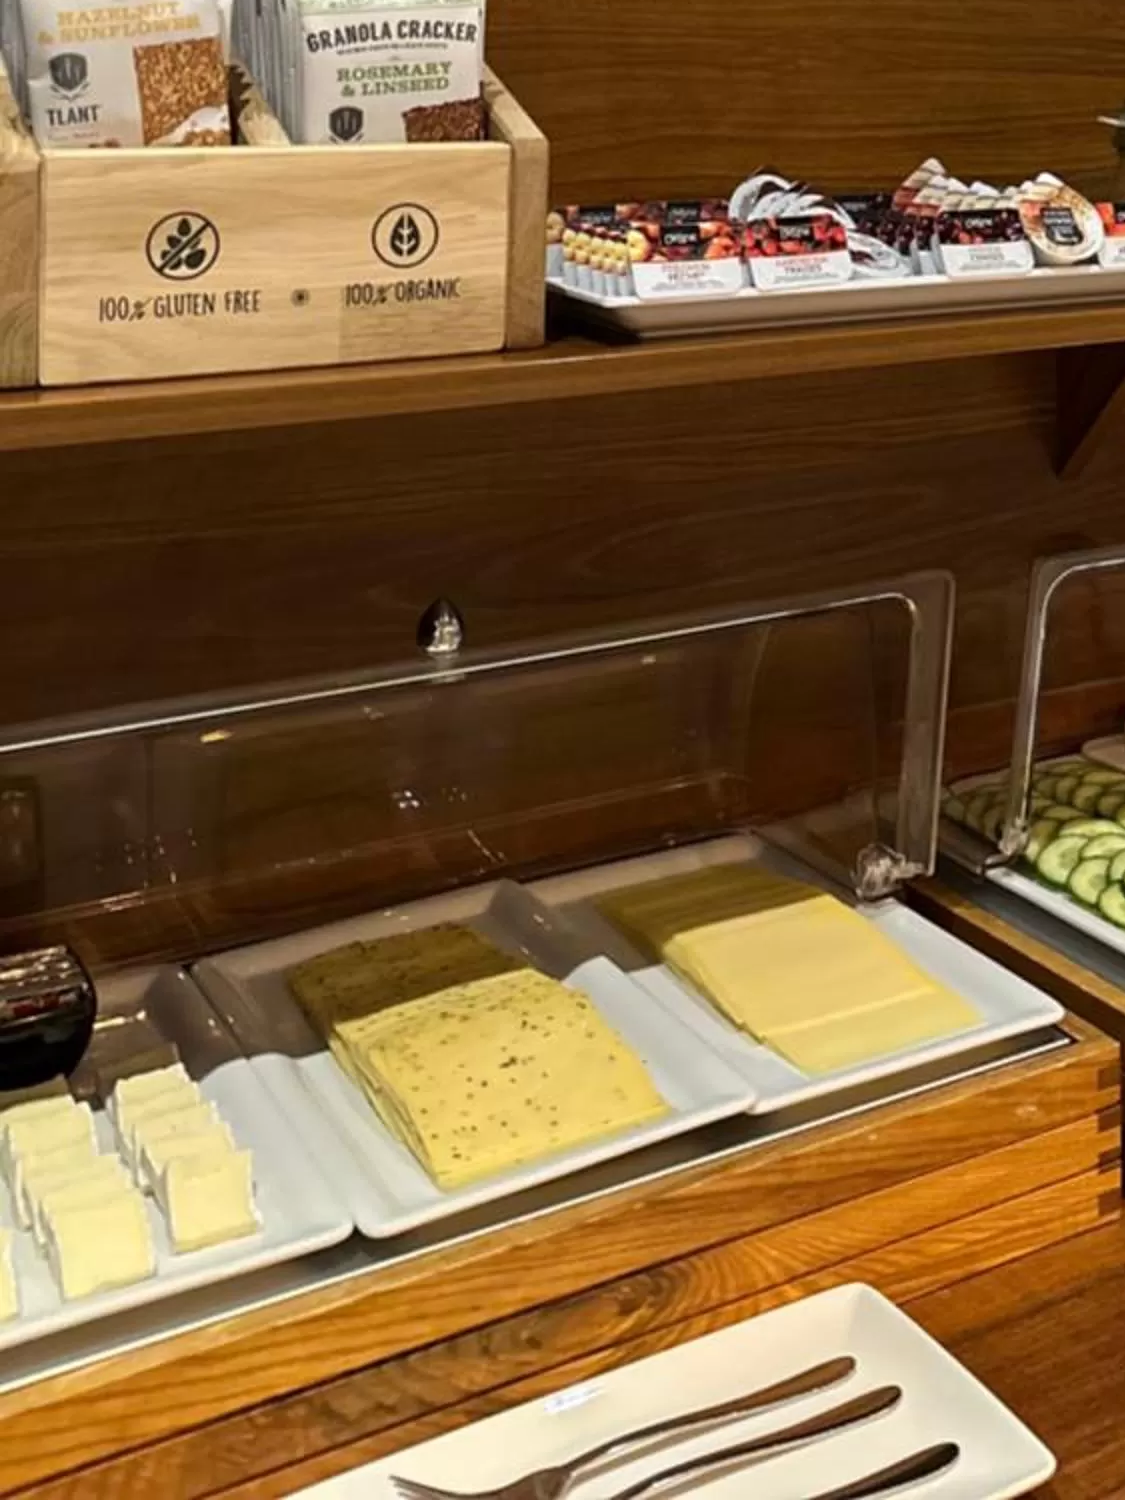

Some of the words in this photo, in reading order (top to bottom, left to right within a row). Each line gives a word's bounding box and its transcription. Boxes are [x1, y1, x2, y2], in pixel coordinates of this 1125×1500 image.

[306, 21, 393, 53] GRANOLA
[397, 19, 477, 43] CRACKER
[336, 61, 453, 82] ROSEMARY
[340, 84, 356, 97] &
[361, 77, 450, 97] LINSEED
[45, 104, 102, 127] TLANT
[345, 281, 393, 308] 100%
[395, 276, 461, 303] ORGANIC
[99, 296, 152, 323] 100%
[153, 292, 216, 319] GLUTEN
[224, 289, 262, 314] FREE
